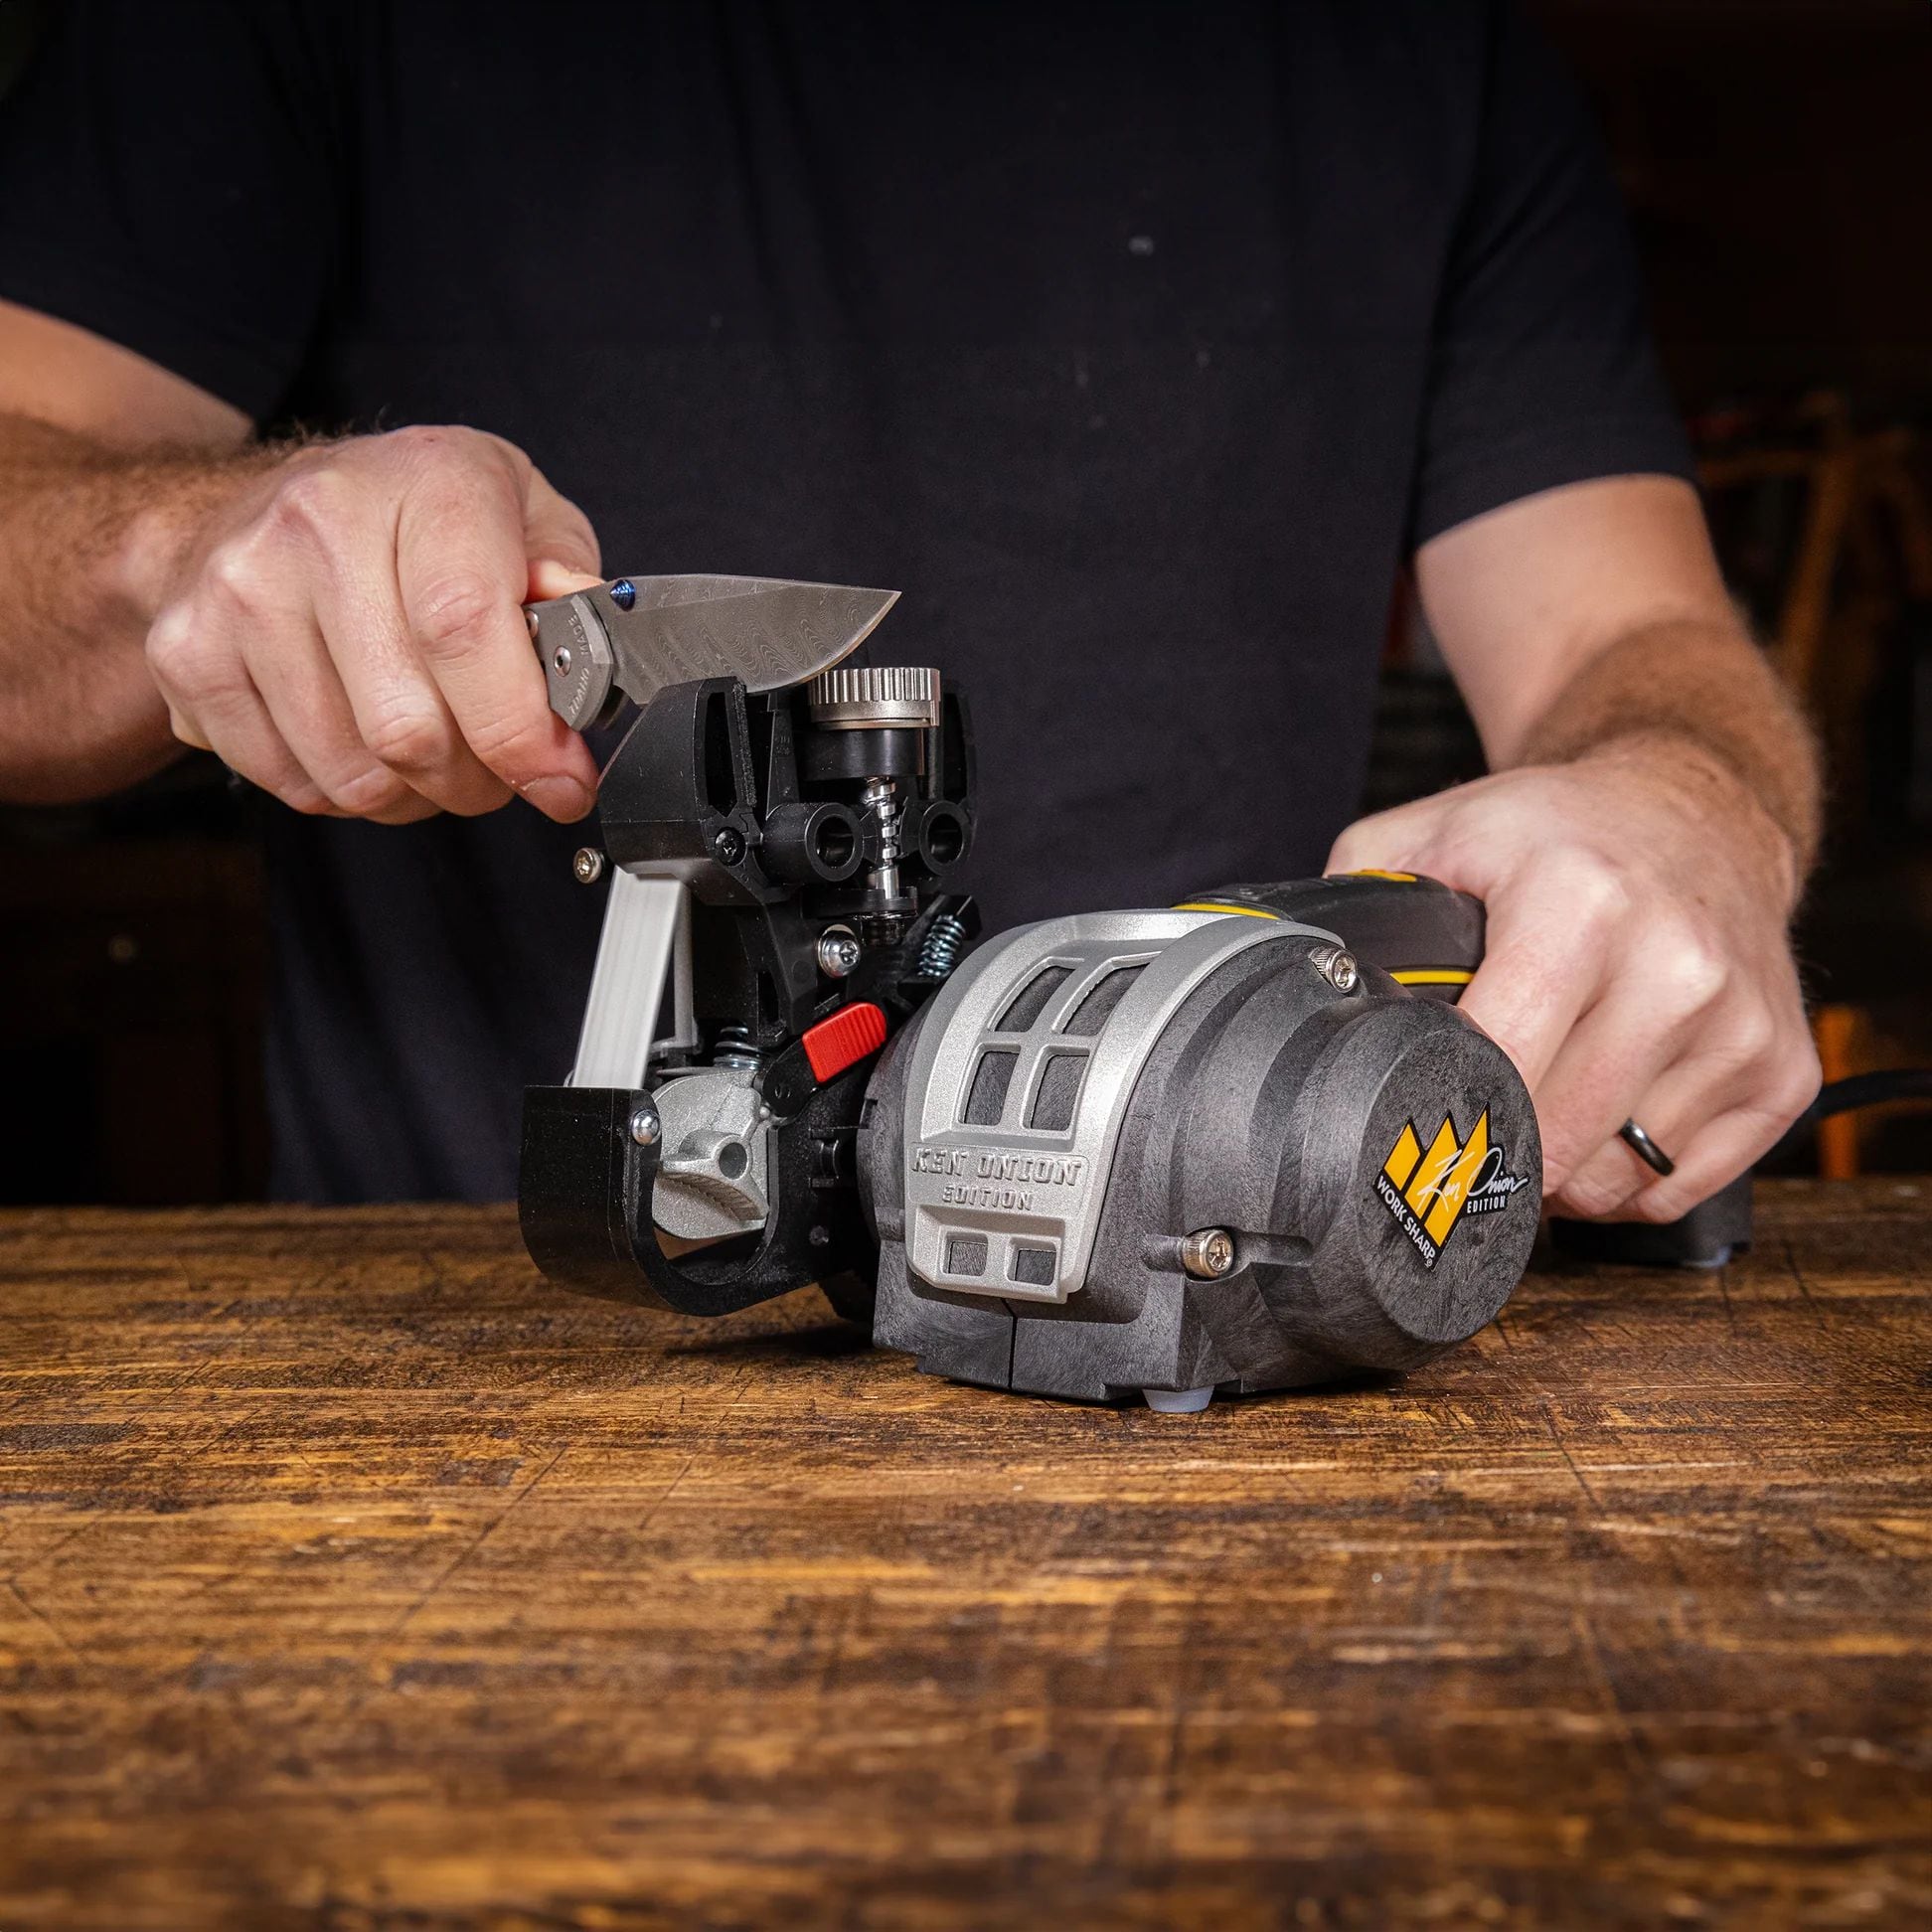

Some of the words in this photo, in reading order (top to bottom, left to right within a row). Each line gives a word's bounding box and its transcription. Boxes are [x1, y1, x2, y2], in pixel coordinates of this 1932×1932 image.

[567, 614, 590, 656] MADE
[567, 668, 590, 718] IDAHO
[911, 1147, 969, 1176] KEN
[976, 1152, 1082, 1186] ONION
[941, 1184, 1035, 1210] EDITION
[1376, 1175, 1407, 1223] WORK
[1466, 1195, 1507, 1214] EDITION
